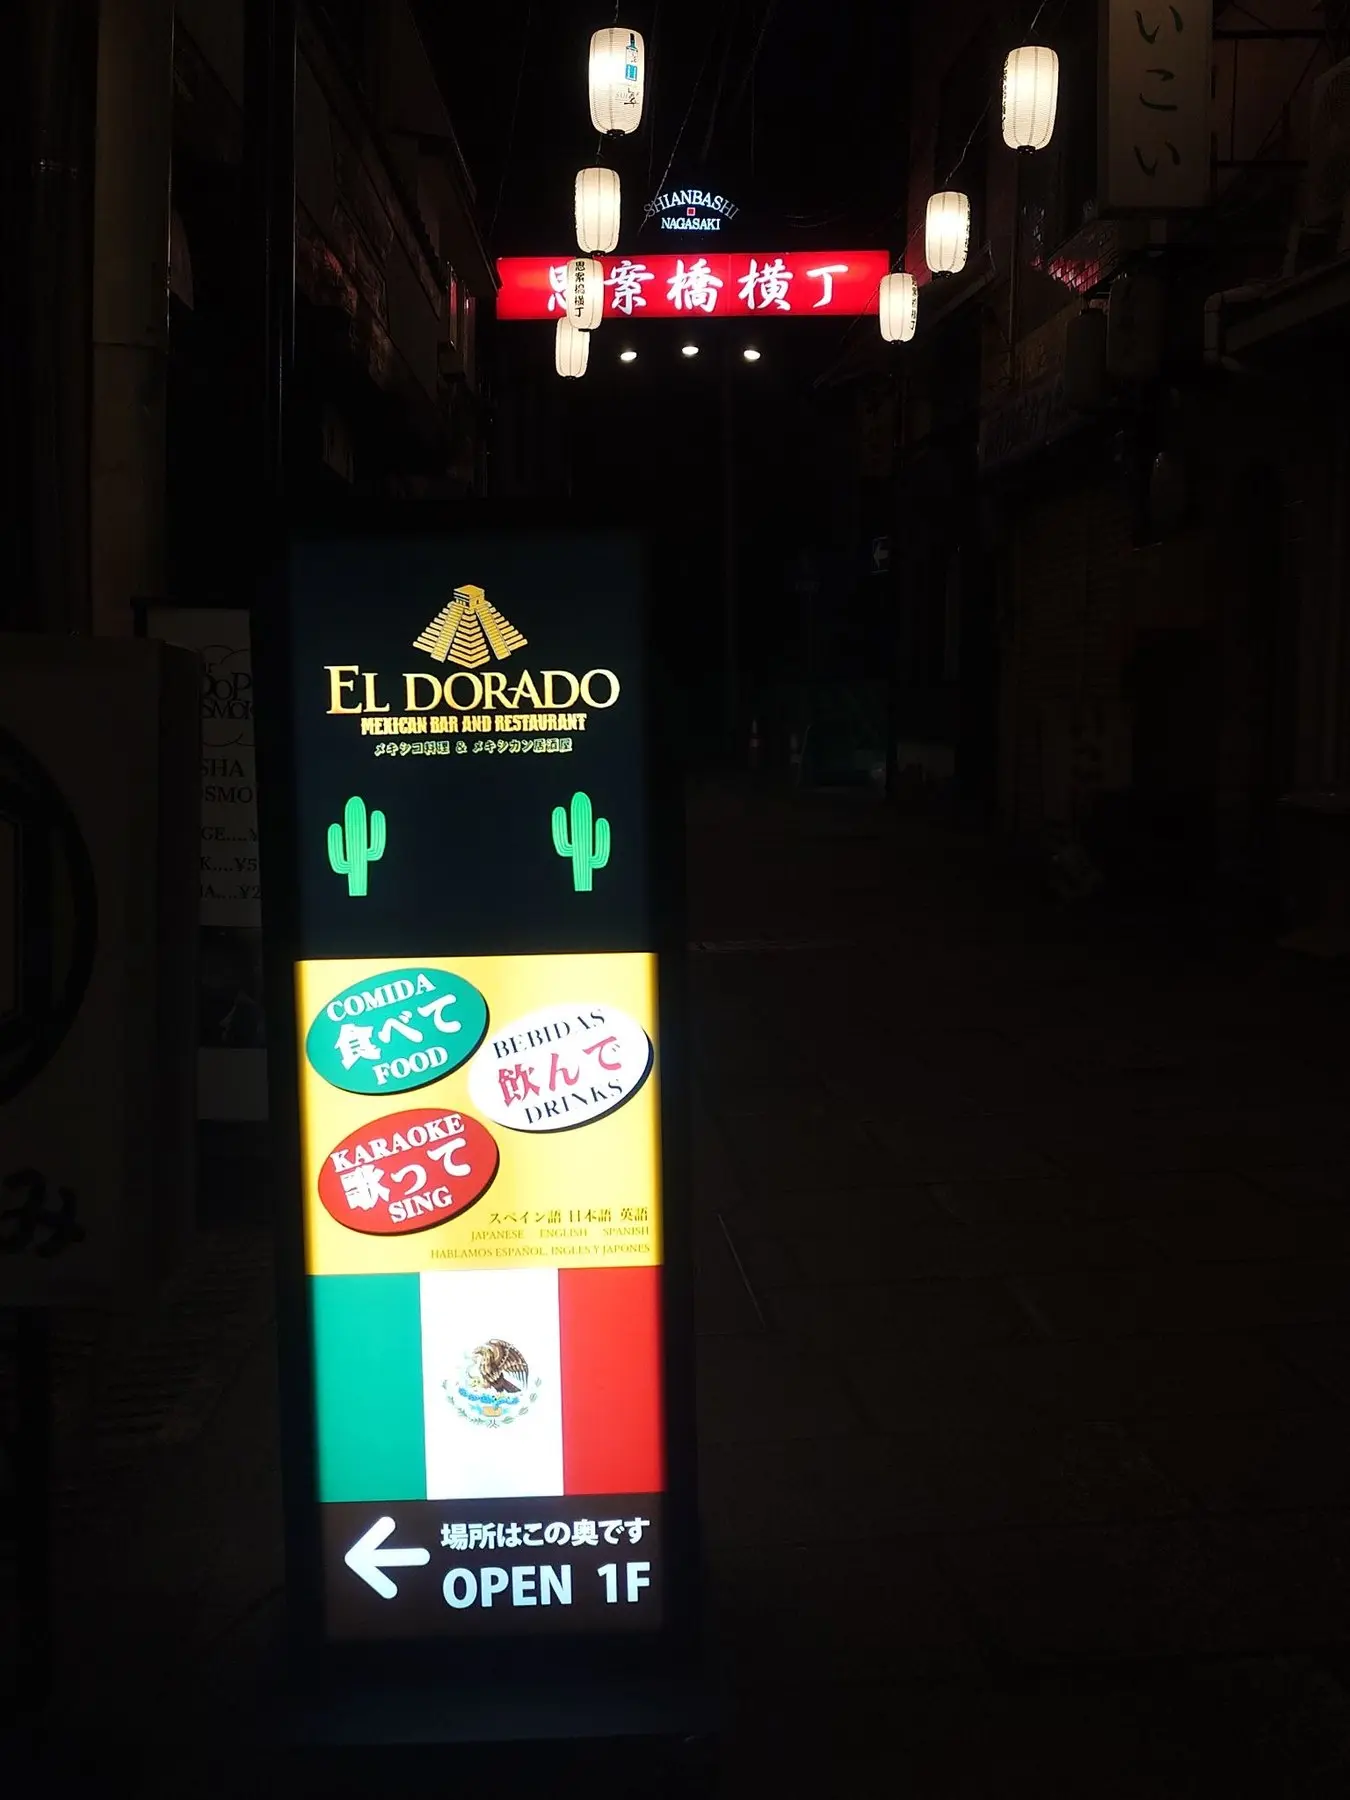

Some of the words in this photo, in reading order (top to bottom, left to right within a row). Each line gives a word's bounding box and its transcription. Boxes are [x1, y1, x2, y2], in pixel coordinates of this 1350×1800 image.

[1135, 6, 1183, 178] いこい
[643, 189, 740, 220] SHIANBASHI
[661, 217, 721, 230] NAGASAKI
[324, 665, 390, 715] EL
[402, 668, 621, 712] DORADO
[361, 716, 428, 735] MEXICAN
[430, 716, 459, 733] BAR
[461, 715, 492, 732] AND
[494, 713, 587, 731] RESTAURANT
[374, 741, 451, 756] メキシコ料理
[455, 740, 468, 753] &
[472, 738, 573, 754] メキシカン居酒屋
[326, 973, 436, 1021] COMIDA
[334, 993, 462, 1070] 食べて
[493, 1009, 605, 1058] BEBIDAS
[372, 1046, 449, 1085] FOOD
[498, 1035, 622, 1107] 飲んで
[525, 1079, 623, 1123] DRINKS
[330, 1113, 465, 1173] KARAOKE
[340, 1137, 472, 1211] 歌って
[388, 1186, 453, 1223] SING
[490, 1210, 561, 1225] スペイン語
[569, 1208, 612, 1223] 日本語
[620, 1207, 648, 1223] 英語
[431, 1248, 493, 1259] HABLAMOS
[593, 1244, 600, 1255] Y
[471, 1230, 524, 1242] JAPANESE
[540, 1228, 588, 1239] ENGLISH
[603, 1226, 649, 1237] SPANISH
[440, 1517, 651, 1550] 場所はこの奥です
[442, 1564, 572, 1609] OPEN
[597, 1561, 651, 1603] 1F
